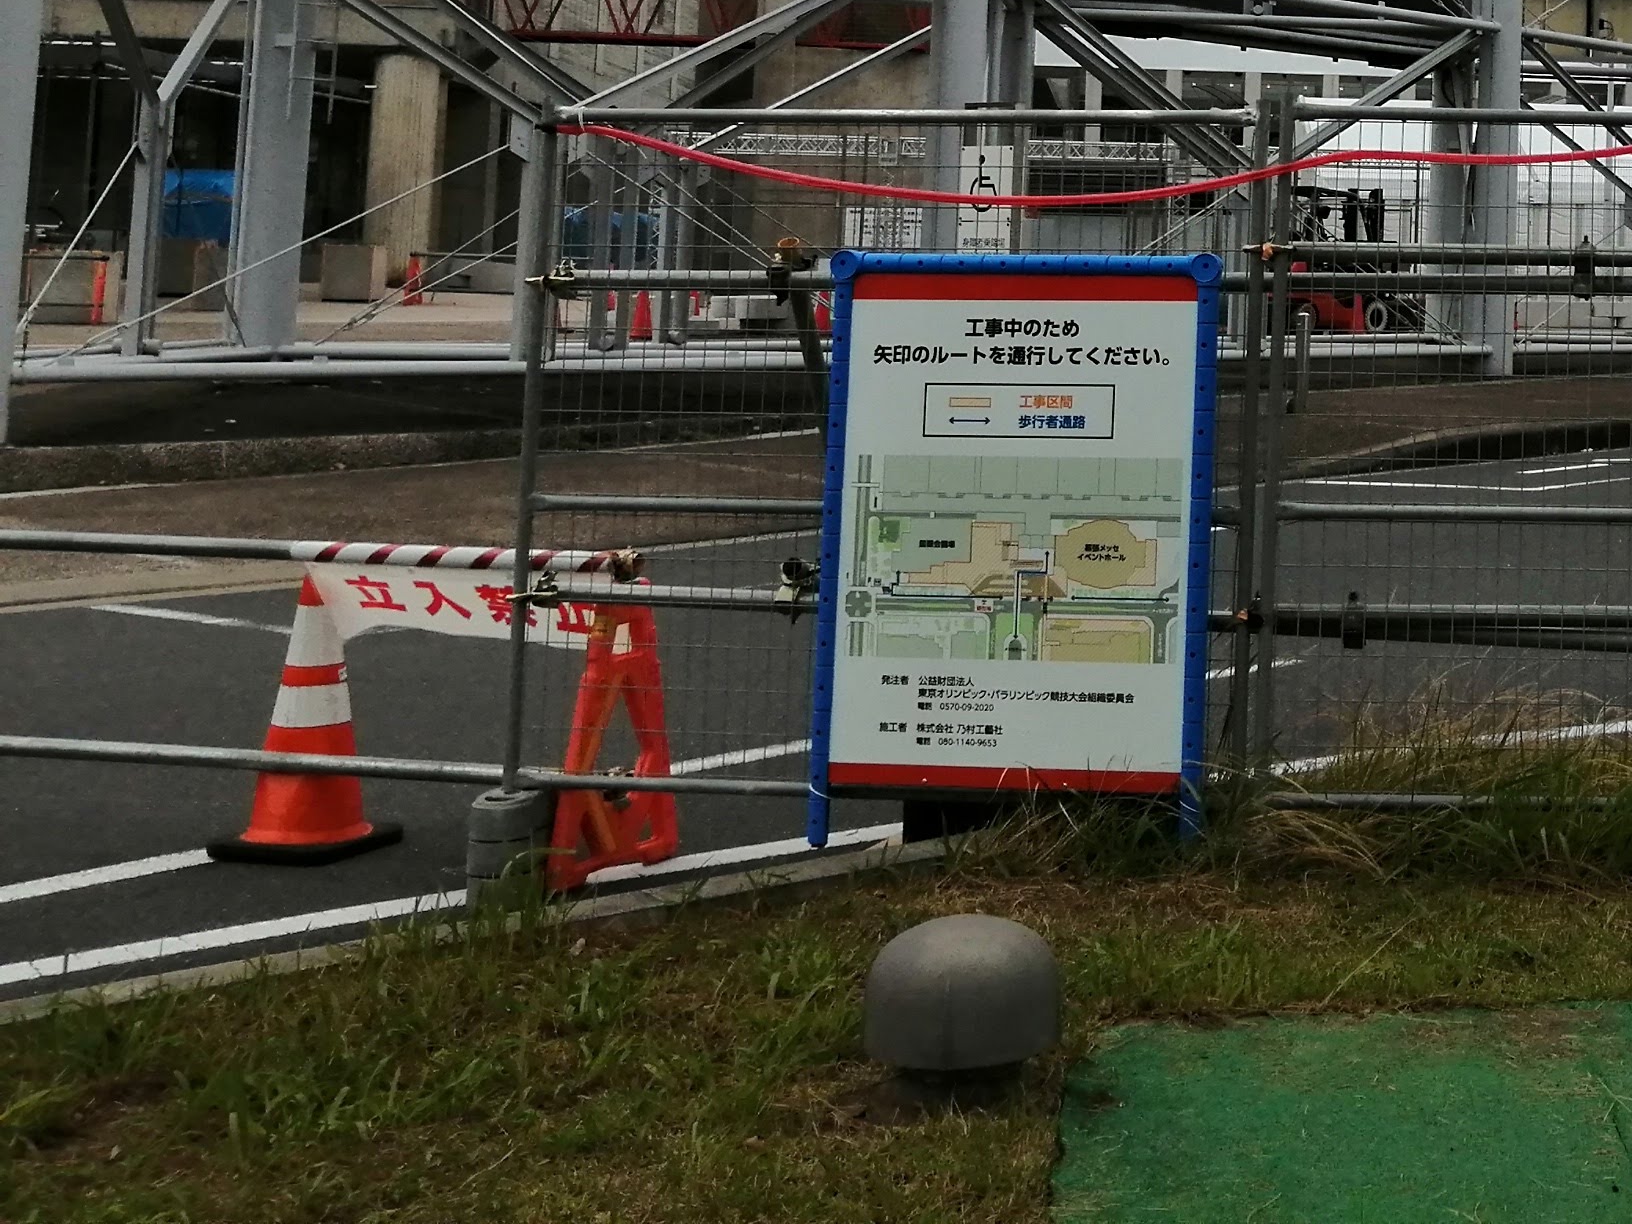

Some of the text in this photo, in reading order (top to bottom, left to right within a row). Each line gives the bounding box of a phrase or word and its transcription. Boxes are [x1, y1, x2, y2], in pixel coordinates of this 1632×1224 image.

[965, 318, 1080, 338] 工事中のため
[873, 344, 1171, 366] 矢印のルートを通行してください。
[1019, 395, 1073, 409] 工事区間
[1018, 415, 1086, 429] 歩行者通路
[1077, 553, 1126, 561] イベントホール
[881, 675, 975, 687] 発注者 公益財団法人
[939, 702, 994, 712] 0570-09-2020
[879, 722, 907, 732] 施工者
[916, 723, 953, 733] 株式会社
[937, 737, 997, 747] 080-1140-9653
